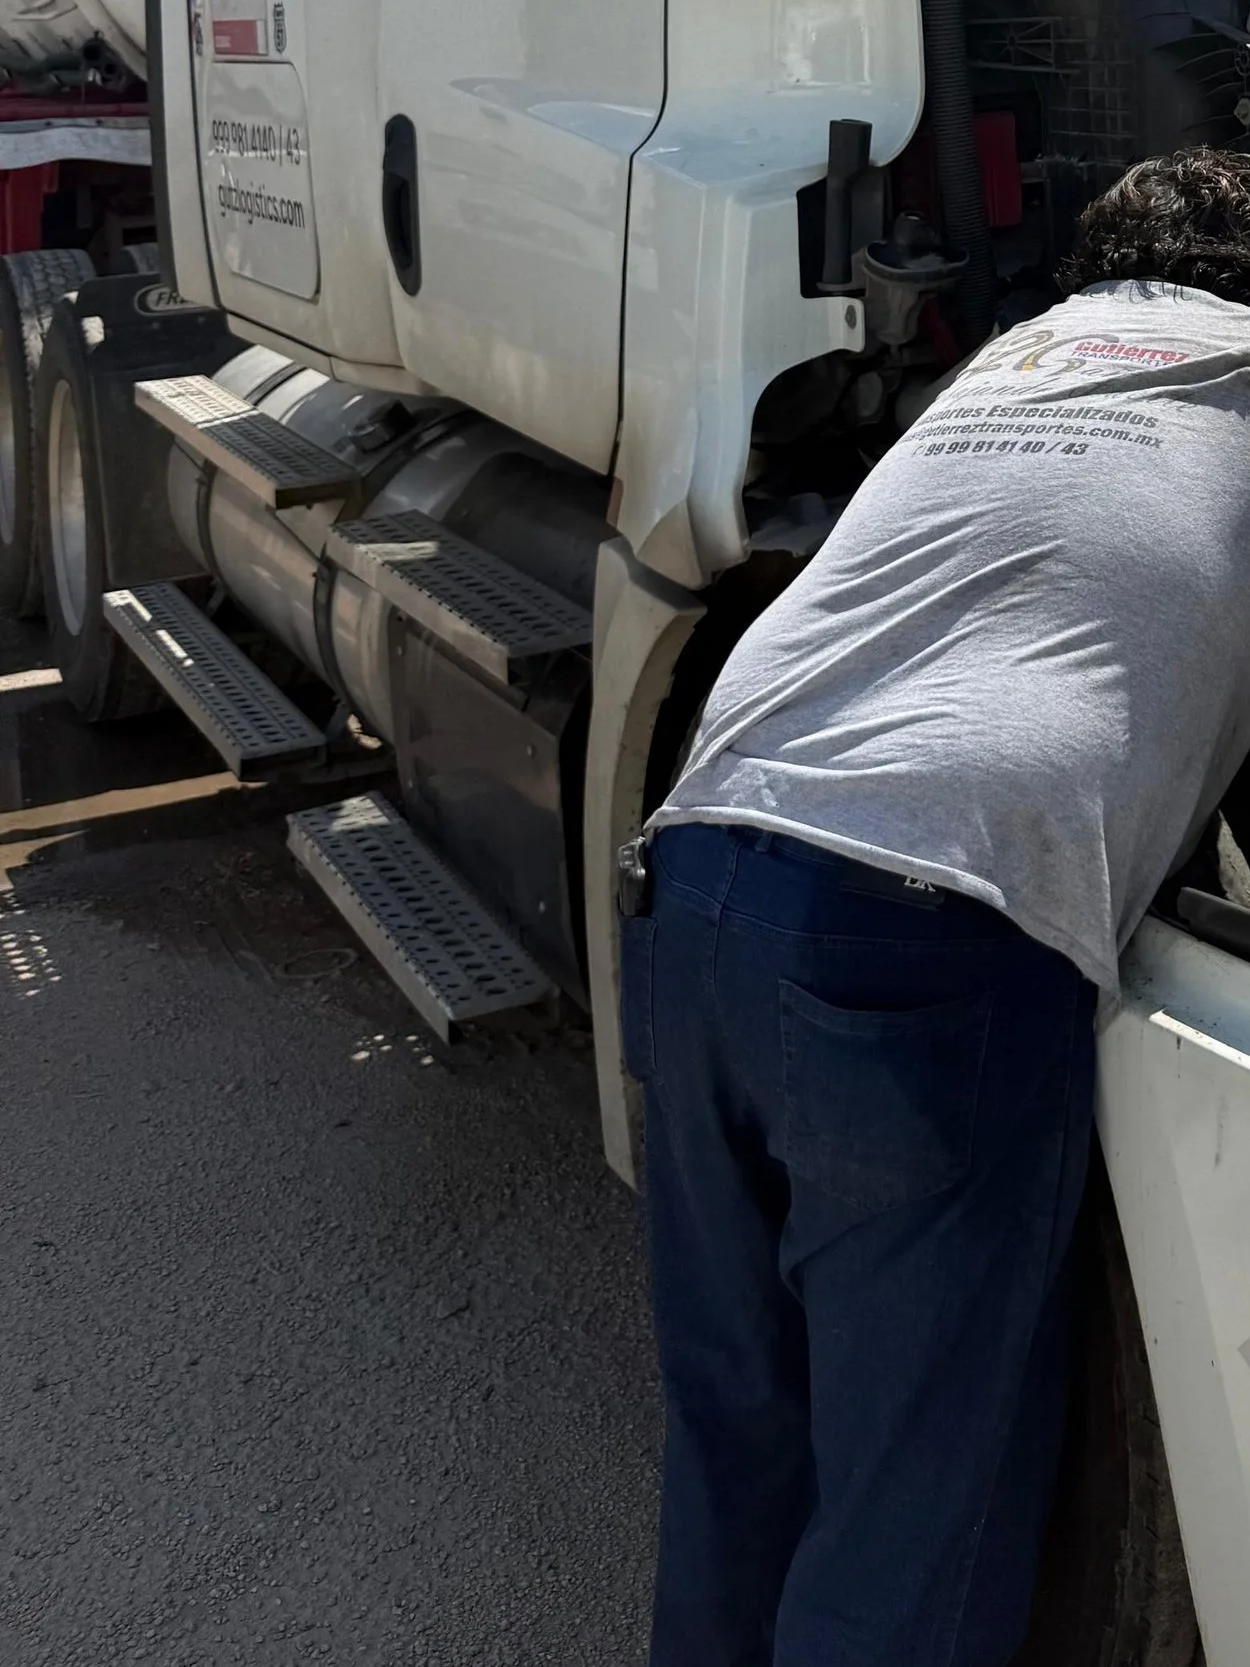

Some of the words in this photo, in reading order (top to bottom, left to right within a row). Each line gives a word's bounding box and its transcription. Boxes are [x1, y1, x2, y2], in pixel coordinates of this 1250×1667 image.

[251, 123, 276, 162] 4140
[286, 127, 301, 166] 43
[985, 404, 1160, 429] Especializados
[945, 440, 972, 454] 99
[1061, 442, 1090, 456] 43
